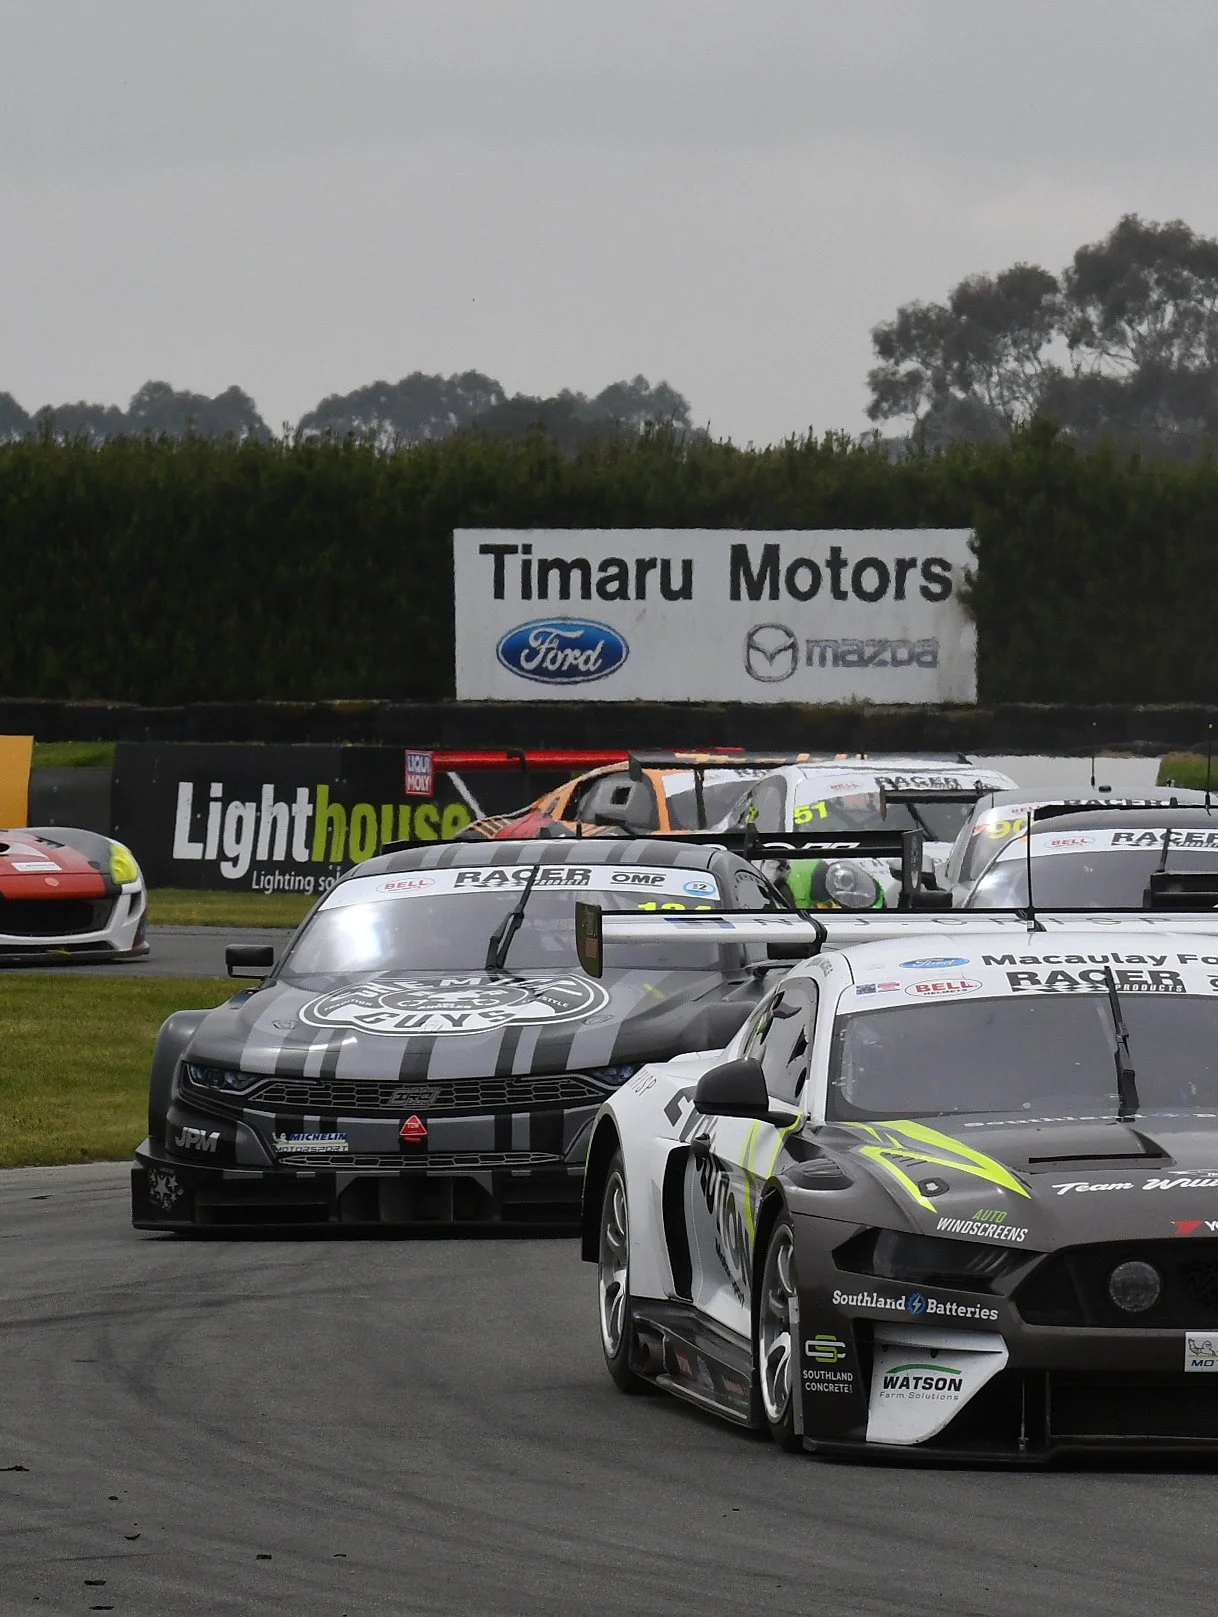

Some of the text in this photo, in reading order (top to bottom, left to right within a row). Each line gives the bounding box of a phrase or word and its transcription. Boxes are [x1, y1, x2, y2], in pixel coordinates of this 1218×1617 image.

[479, 543, 953, 602] Timaru Motors
[520, 629, 602, 672] Ford
[805, 637, 939, 669] mazda
[407, 774, 432, 792] MOLY
[794, 801, 828, 824] 51
[173, 781, 472, 879] Lighthouse
[1051, 837, 1089, 847] BELL
[252, 870, 314, 894] Lighting
[384, 878, 426, 890] BELL
[454, 868, 592, 885] RACER
[611, 873, 666, 885] OMP
[912, 959, 960, 968] Ford
[981, 953, 1175, 967] Macaulay
[915, 980, 974, 993] BELL
[1007, 970, 1181, 988] RACER
[1115, 983, 1184, 992] PRODUCTS
[352, 1010, 516, 1028] GUYS
[174, 1126, 221, 1153] JPM
[289, 1132, 348, 1141] MICHELIN
[1052, 1180, 1134, 1195] Team
[972, 1208, 1008, 1223] AUTO
[936, 1216, 1029, 1243] WINDSCREENS
[832, 1289, 999, 1320] Southland Batteries
[802, 1369, 853, 1382] SOUTHLAND
[883, 1375, 963, 1392] WATSON
[879, 1391, 959, 1401] Farm Solutions
